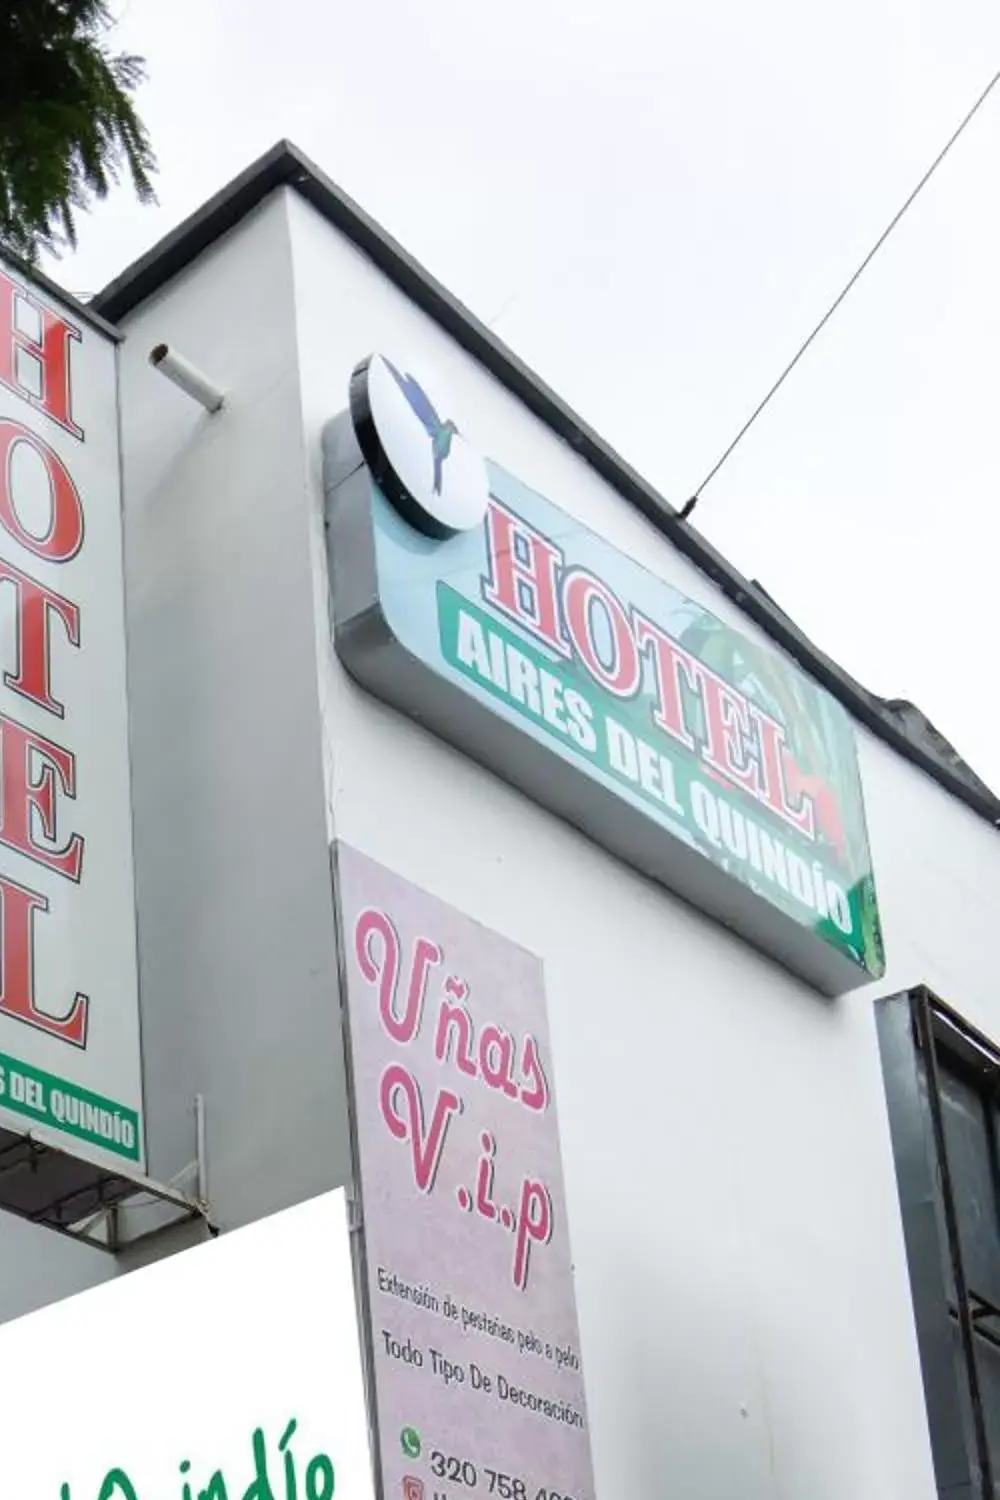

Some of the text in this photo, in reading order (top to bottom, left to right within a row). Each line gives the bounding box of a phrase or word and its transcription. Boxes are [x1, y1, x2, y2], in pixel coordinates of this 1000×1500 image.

[480, 496, 816, 842] HOTEL
[456, 609, 853, 934] AIRES DEL QUINDÍO
[355, 907, 549, 1112] Uñas
[10, 1071, 47, 1113] DEL
[51, 1089, 135, 1148] QUINDÍO
[377, 1267, 581, 1371] Extensión de pestañas pelo a pelo
[382, 1330, 585, 1428] Todo Tipo De Decoración
[431, 1451, 477, 1487] 320
